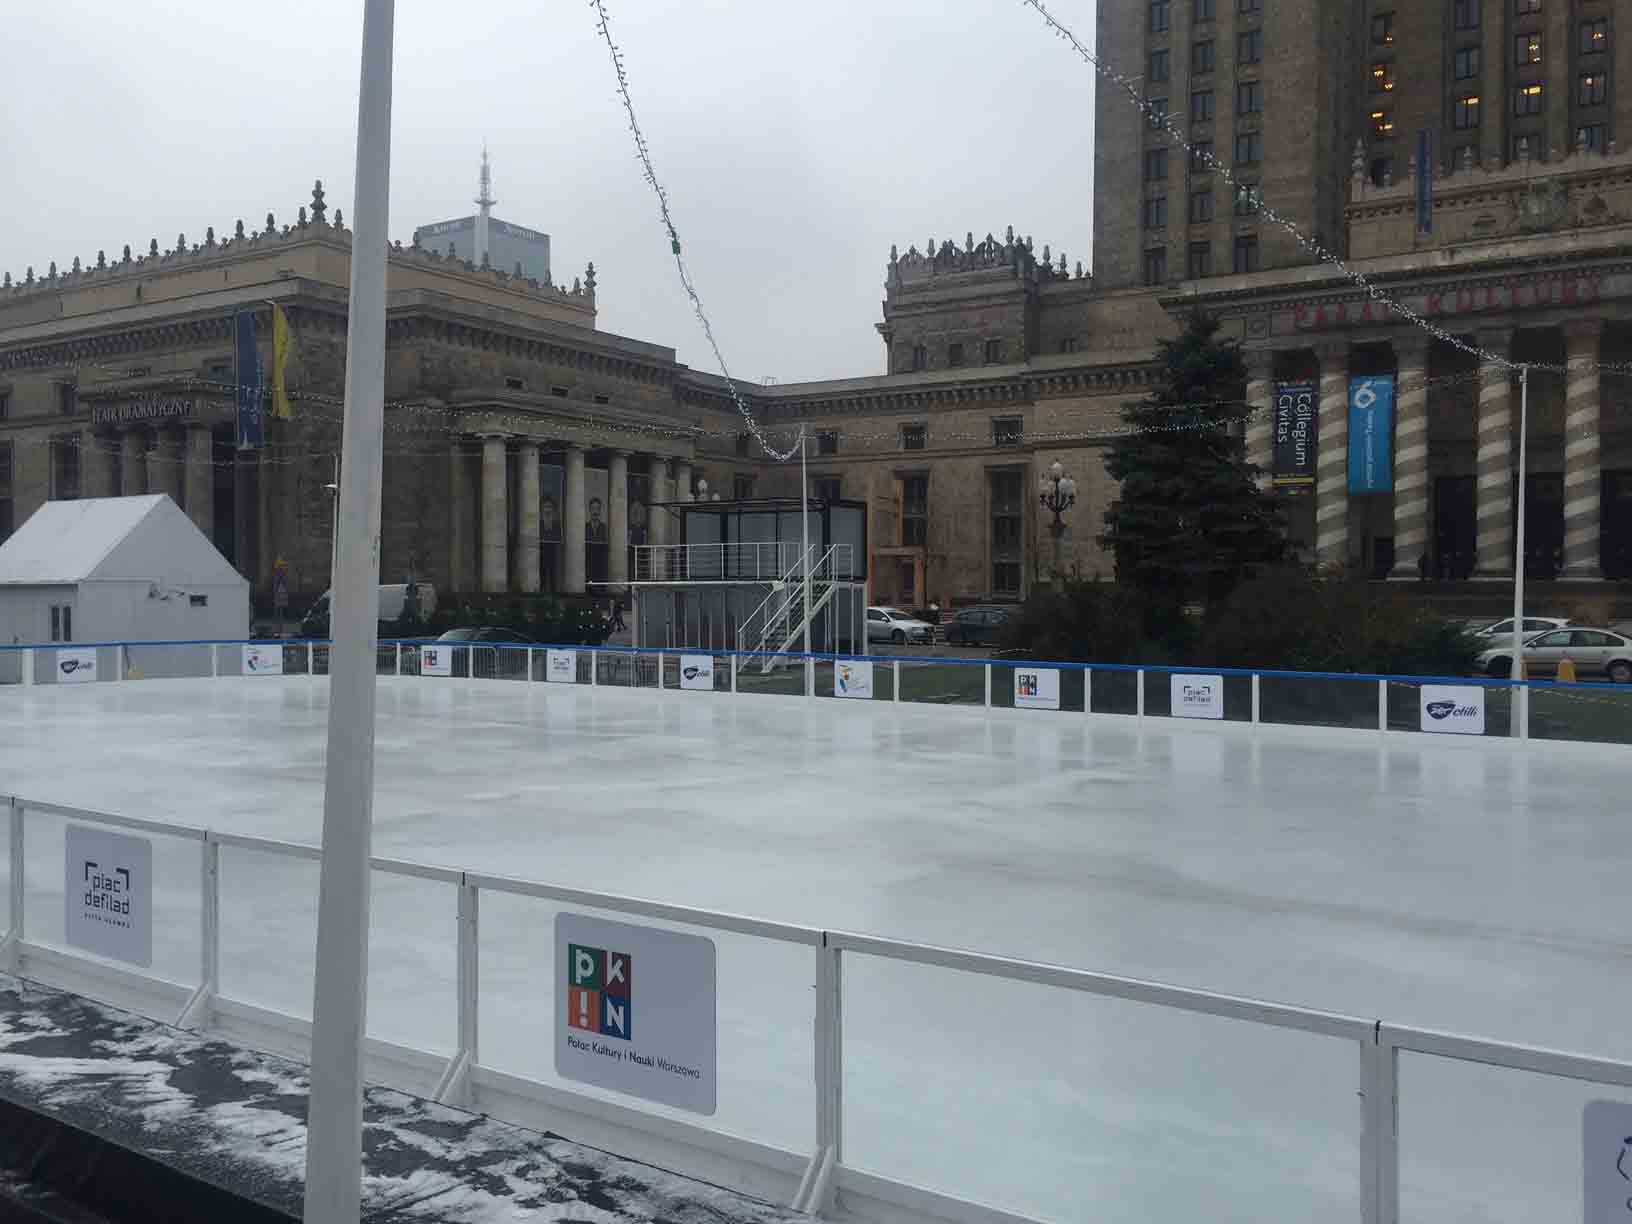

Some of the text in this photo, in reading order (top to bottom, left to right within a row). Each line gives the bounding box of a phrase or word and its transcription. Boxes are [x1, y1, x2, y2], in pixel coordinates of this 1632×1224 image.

[1279, 394, 1293, 443] Civitas
[1292, 393, 1312, 465] Collegium
[85, 889, 130, 914] defilad
[93, 873, 121, 893] plac
[592, 1041, 621, 1061] Kultury
[630, 1050, 655, 1067] Nauki
[657, 1056, 700, 1080] Warszawa
